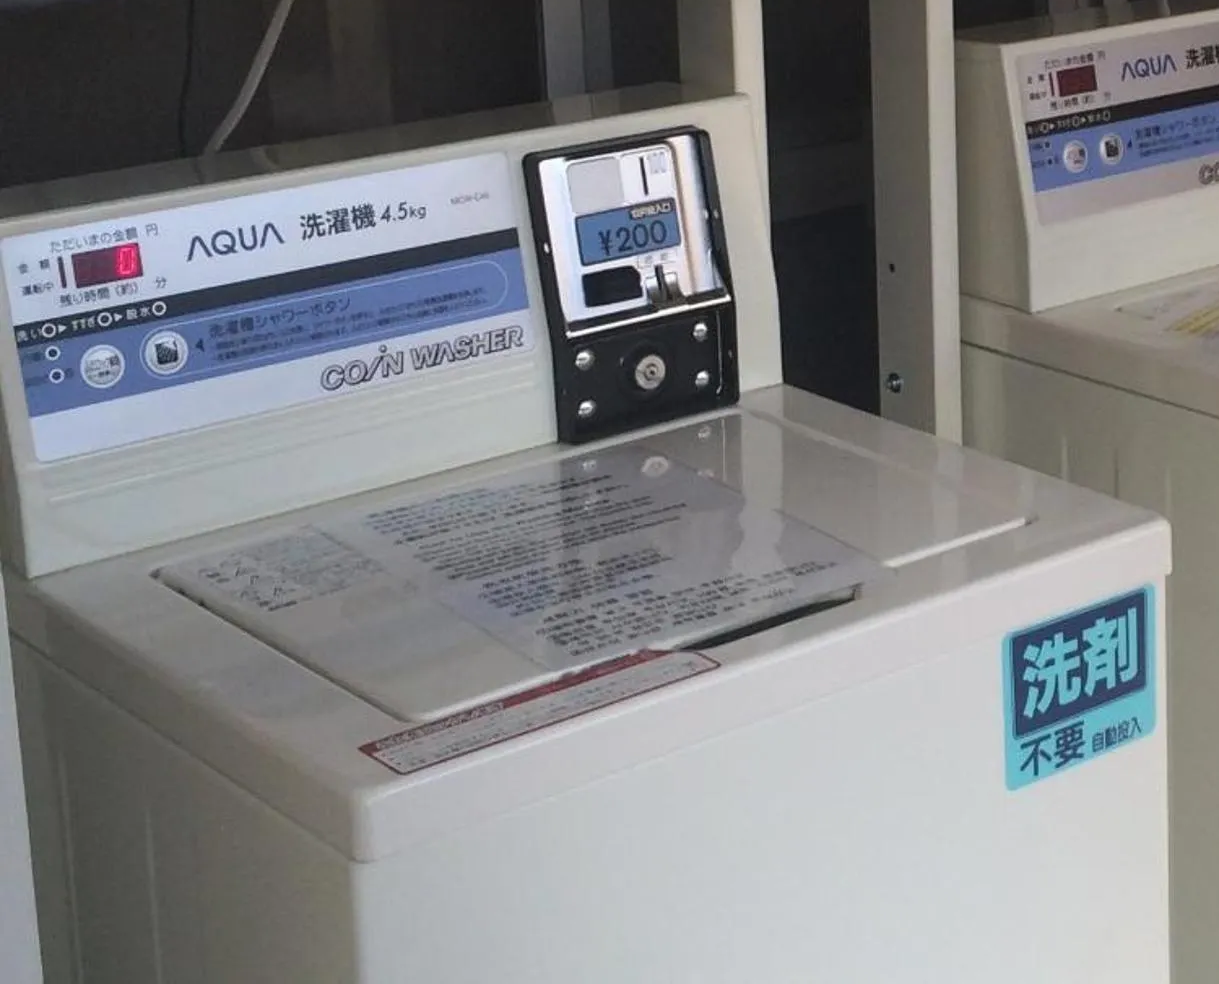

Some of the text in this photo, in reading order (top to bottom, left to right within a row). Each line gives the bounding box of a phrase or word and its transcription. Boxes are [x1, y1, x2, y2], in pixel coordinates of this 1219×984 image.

[1121, 54, 1178, 82] AQUA
[50, 223, 159, 254] ただいまの金額 円
[300, 203, 377, 241] 洗濯機
[380, 201, 427, 224] 4.5kg
[599, 219, 668, 256] ¥200
[187, 222, 285, 262] AQUA
[117, 247, 136, 276] 0
[155, 276, 167, 290] 分
[409, 325, 524, 371] WASHER
[1023, 607, 1137, 718] 洗剤
[1020, 717, 1142, 776] 不要 自動投入
